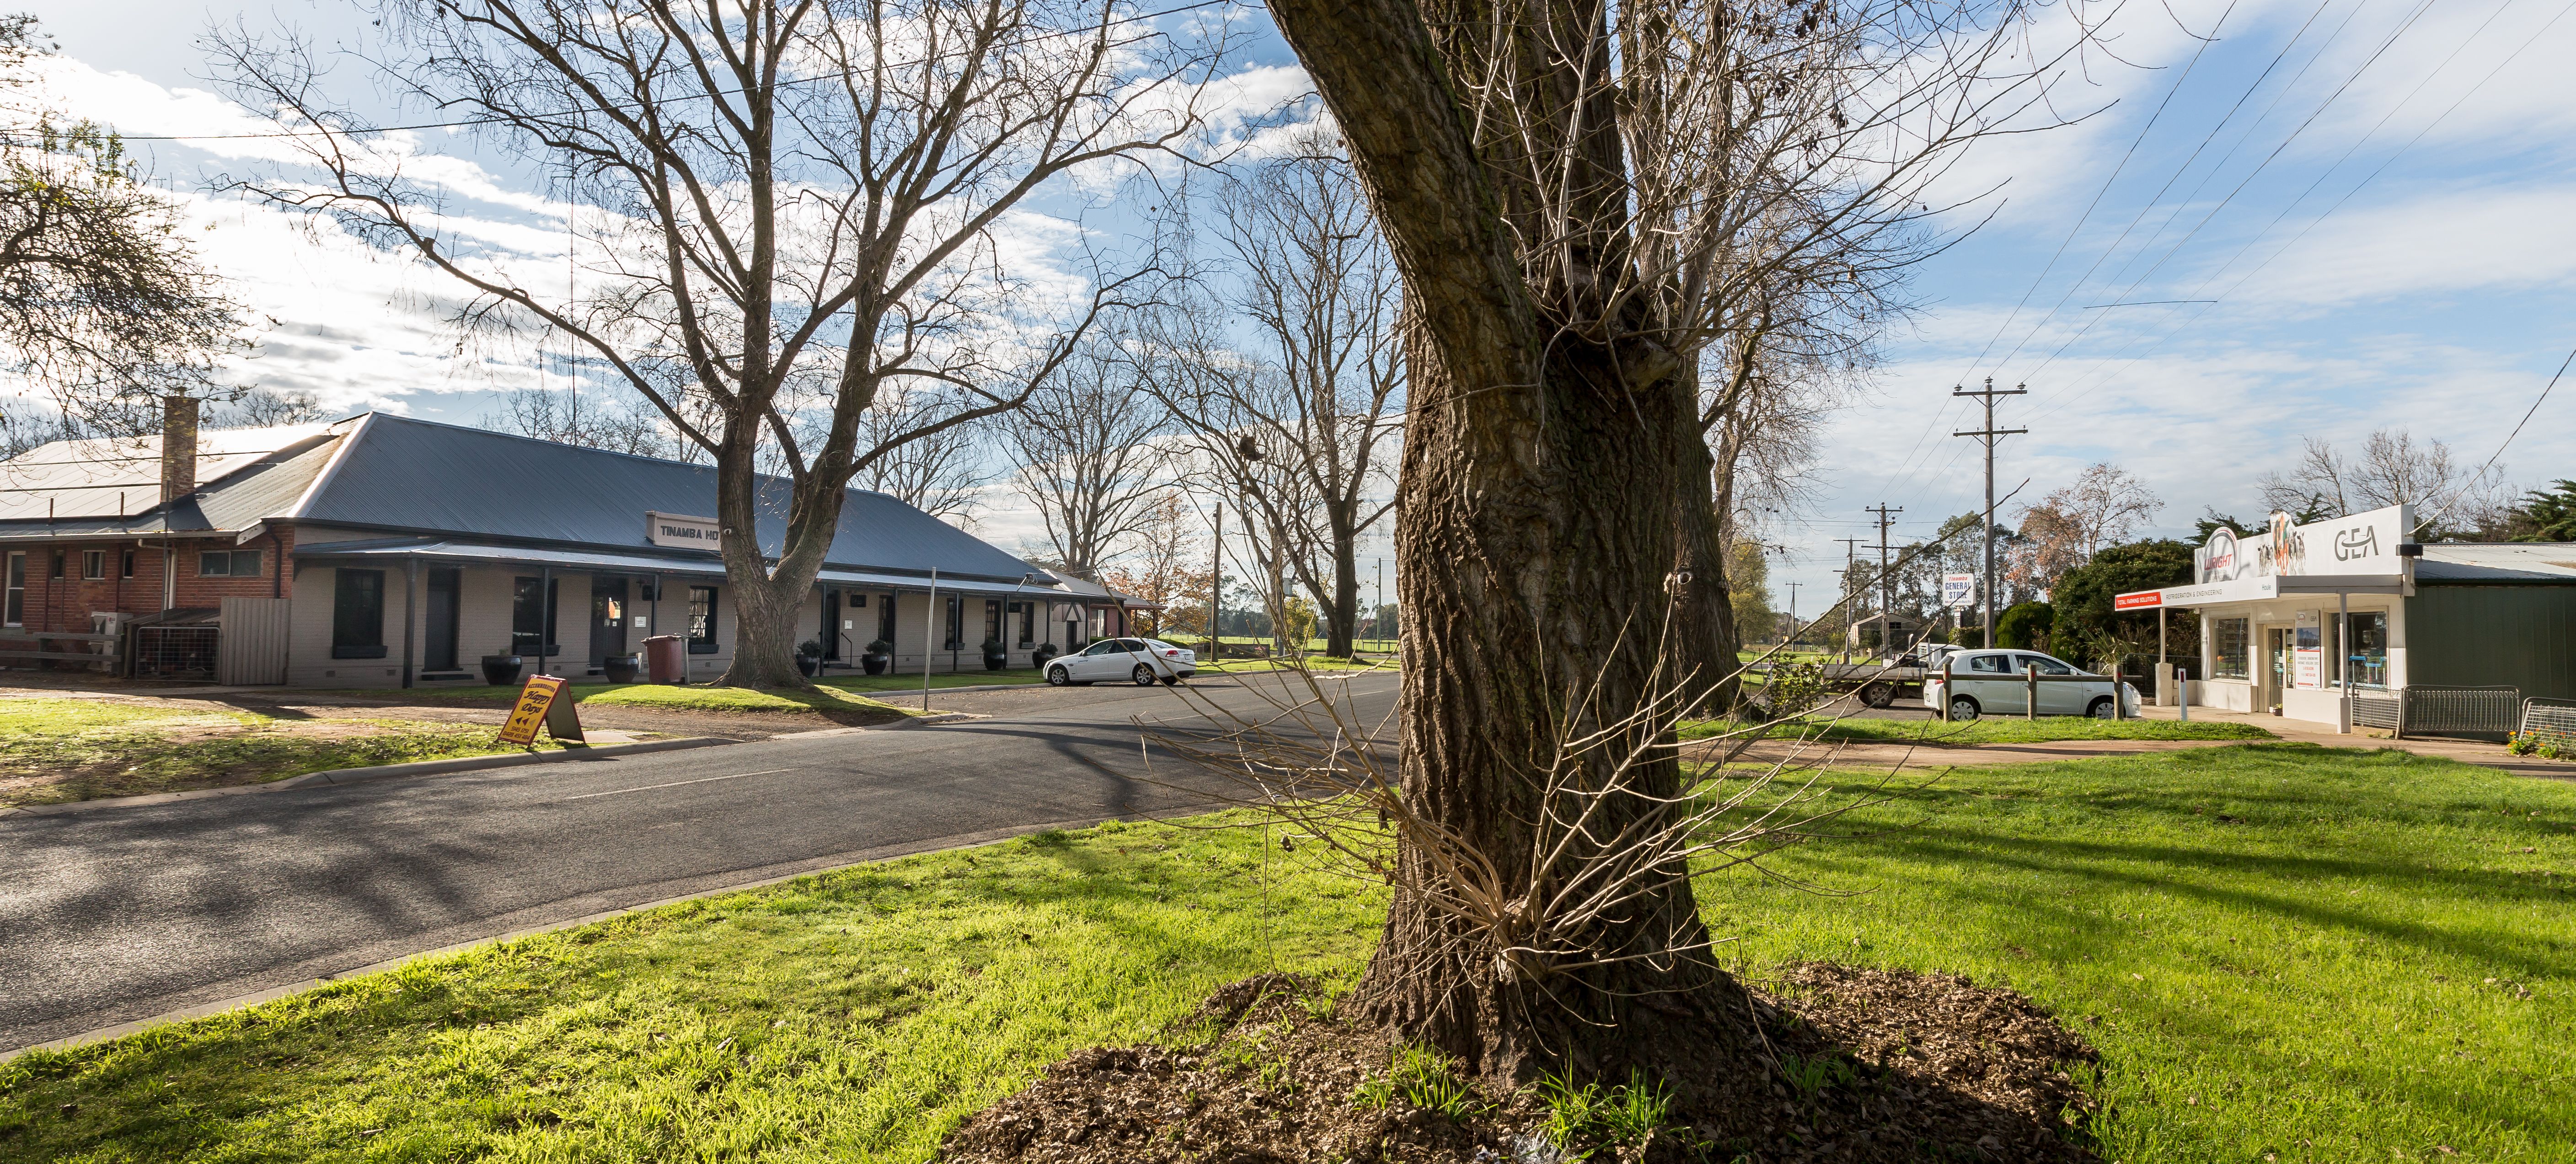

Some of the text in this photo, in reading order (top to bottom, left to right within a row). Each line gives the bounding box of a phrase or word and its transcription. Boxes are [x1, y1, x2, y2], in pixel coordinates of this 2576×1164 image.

[660, 526, 720, 541] TINAMBA HO
[2335, 525, 2379, 562] GEA
[2204, 554, 2232, 570] WRIGHT
[2196, 589, 2222, 597] ENGINEERING
[524, 691, 552, 705] Happy
[521, 703, 543, 715] Days
